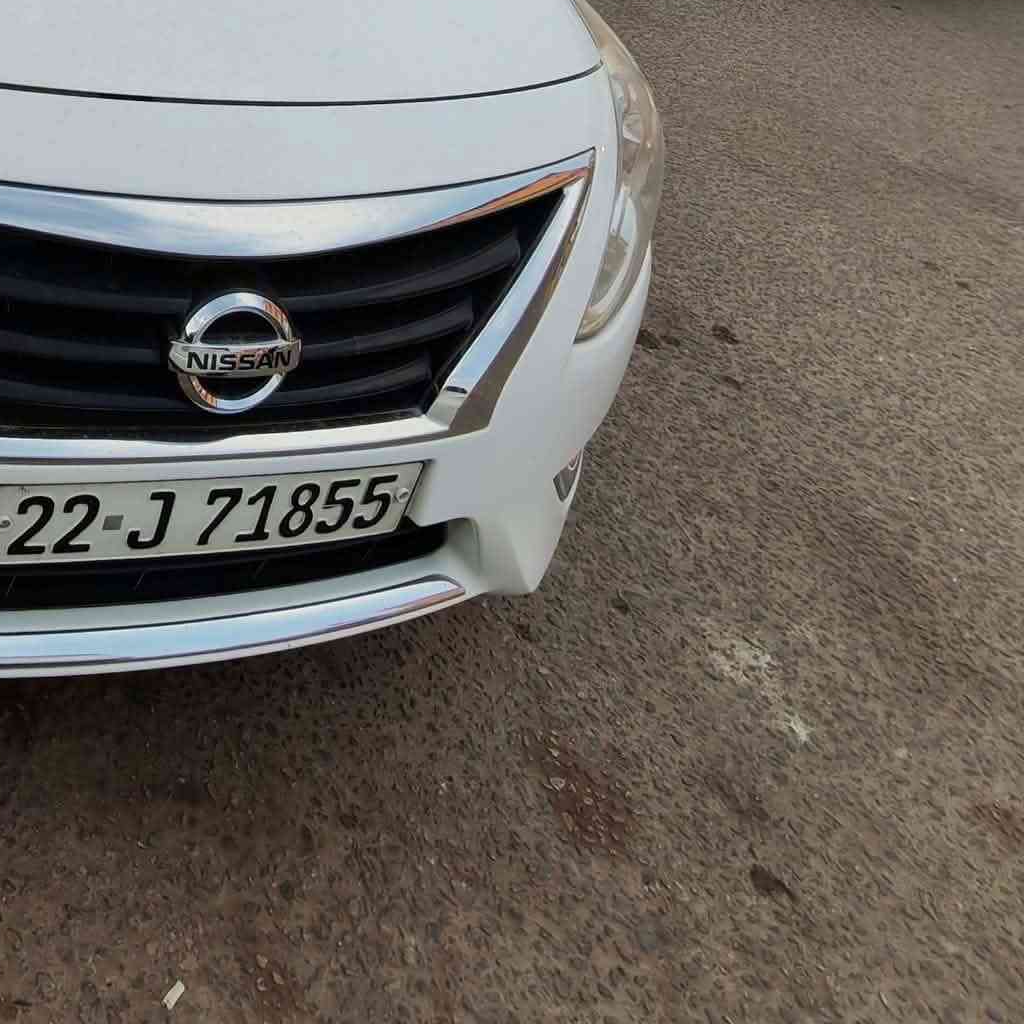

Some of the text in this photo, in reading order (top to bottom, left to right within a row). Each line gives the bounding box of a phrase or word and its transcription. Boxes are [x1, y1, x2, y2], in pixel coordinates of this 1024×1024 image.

[187, 350, 292, 370] NISSAN
[7, 474, 398, 555] 22 J 71855
